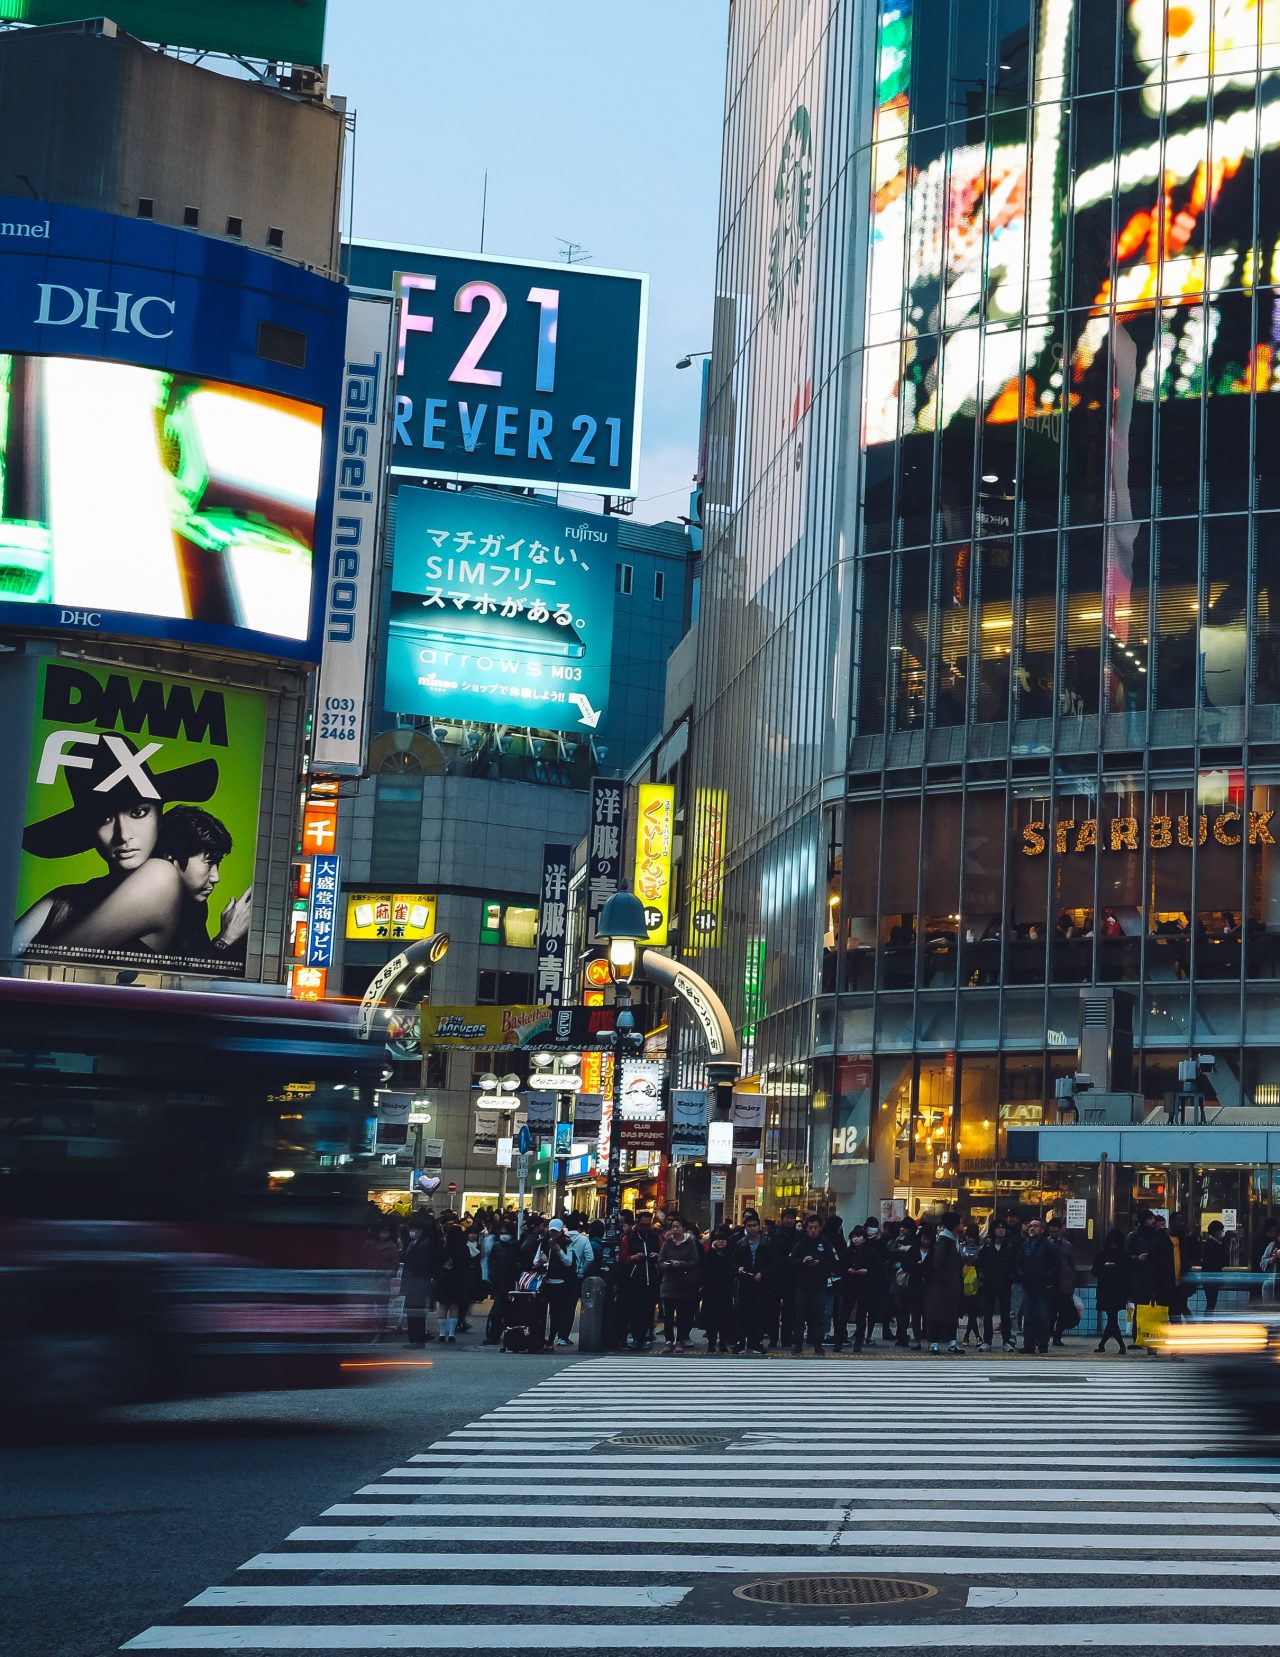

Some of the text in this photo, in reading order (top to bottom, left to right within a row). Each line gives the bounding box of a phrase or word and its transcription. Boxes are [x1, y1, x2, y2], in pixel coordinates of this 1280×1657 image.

[34, 283, 176, 339] DHC
[568, 413, 622, 467] 21
[327, 352, 381, 644] Taisei neon
[564, 522, 608, 543] FUJITSU
[426, 528, 590, 572] マチガイない、
[425, 555, 556, 591] SIMフリー
[60, 610, 101, 628] DHC
[422, 586, 586, 629] スマホがある。
[419, 649, 582, 682] arrows M03
[42, 663, 229, 748] DMM
[320, 713, 357, 727] 3719
[324, 696, 355, 712] (03)
[319, 727, 356, 742] 2468
[36, 730, 164, 800] FX
[310, 861, 337, 963] 大盛堂商事ビル
[376, 903, 408, 920] 麻雀
[678, 1100, 705, 1108] Enjoy
[734, 1104, 762, 1112] Enjoy
